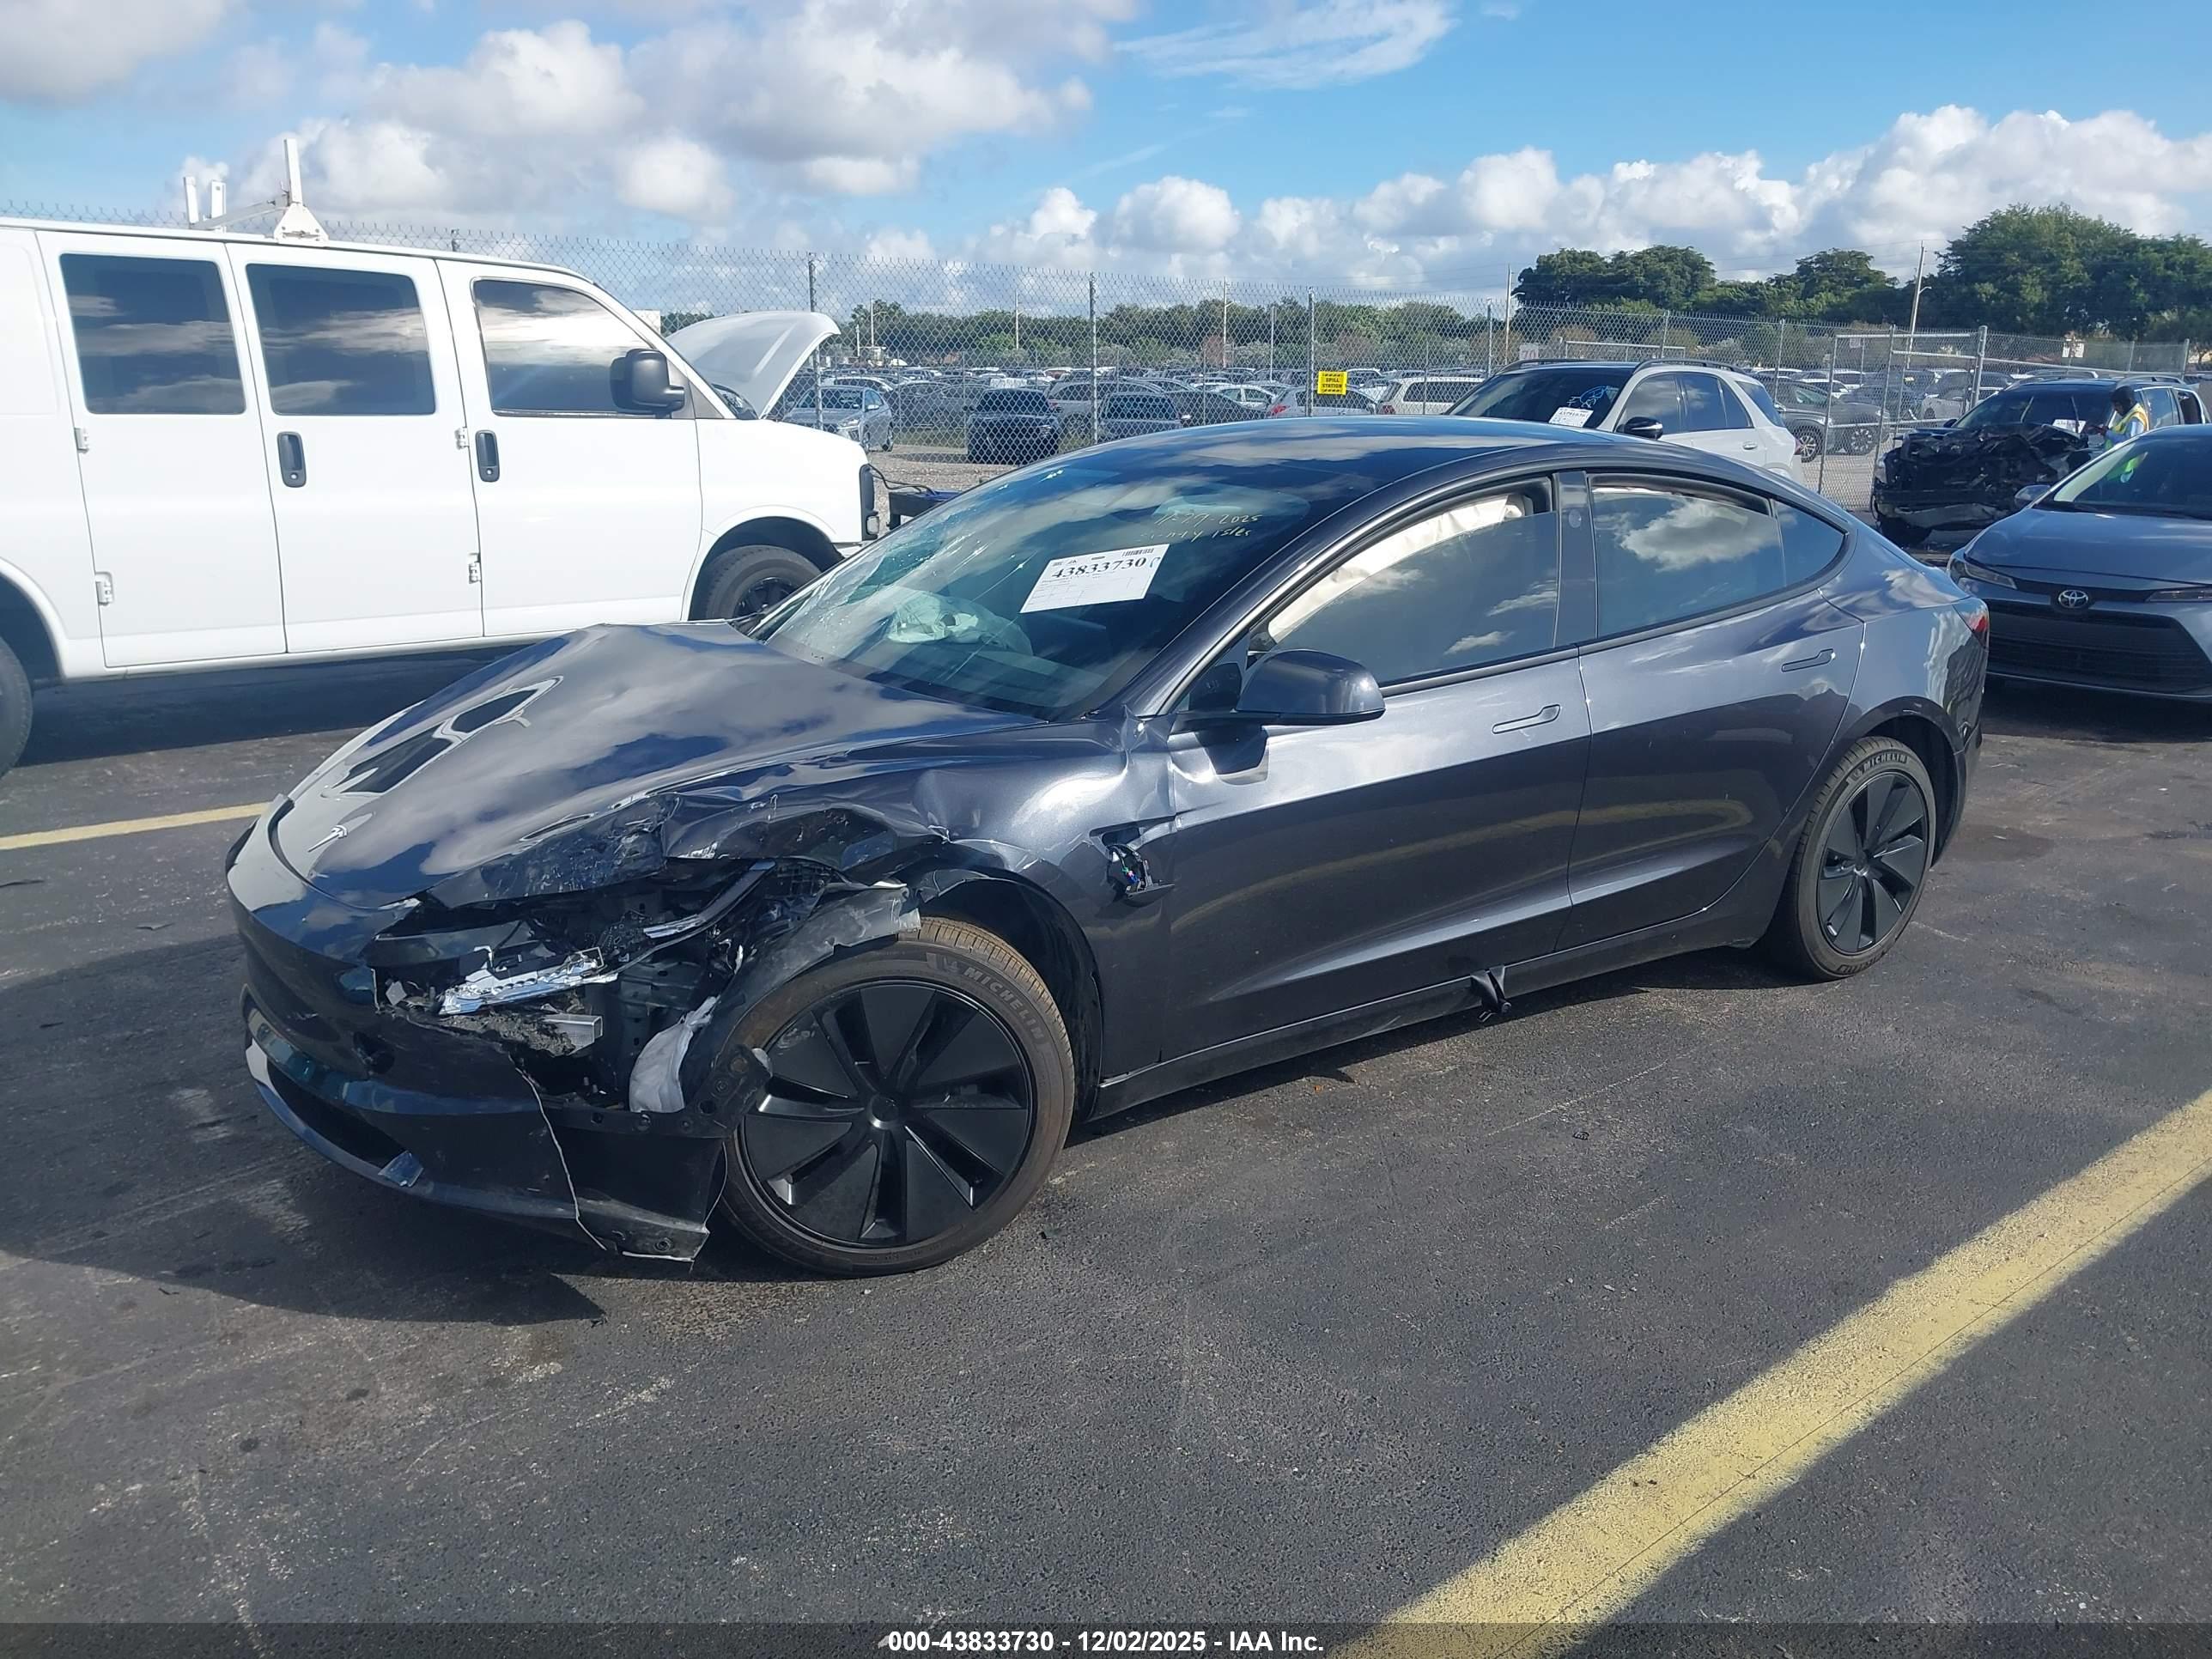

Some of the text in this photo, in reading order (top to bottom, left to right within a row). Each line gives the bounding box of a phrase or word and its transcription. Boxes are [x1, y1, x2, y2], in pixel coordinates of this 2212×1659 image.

[1052, 557, 1146, 579] 43833730
[1863, 752, 1906, 771] MICHELIN
[962, 967, 1046, 1041] MICHELIN
